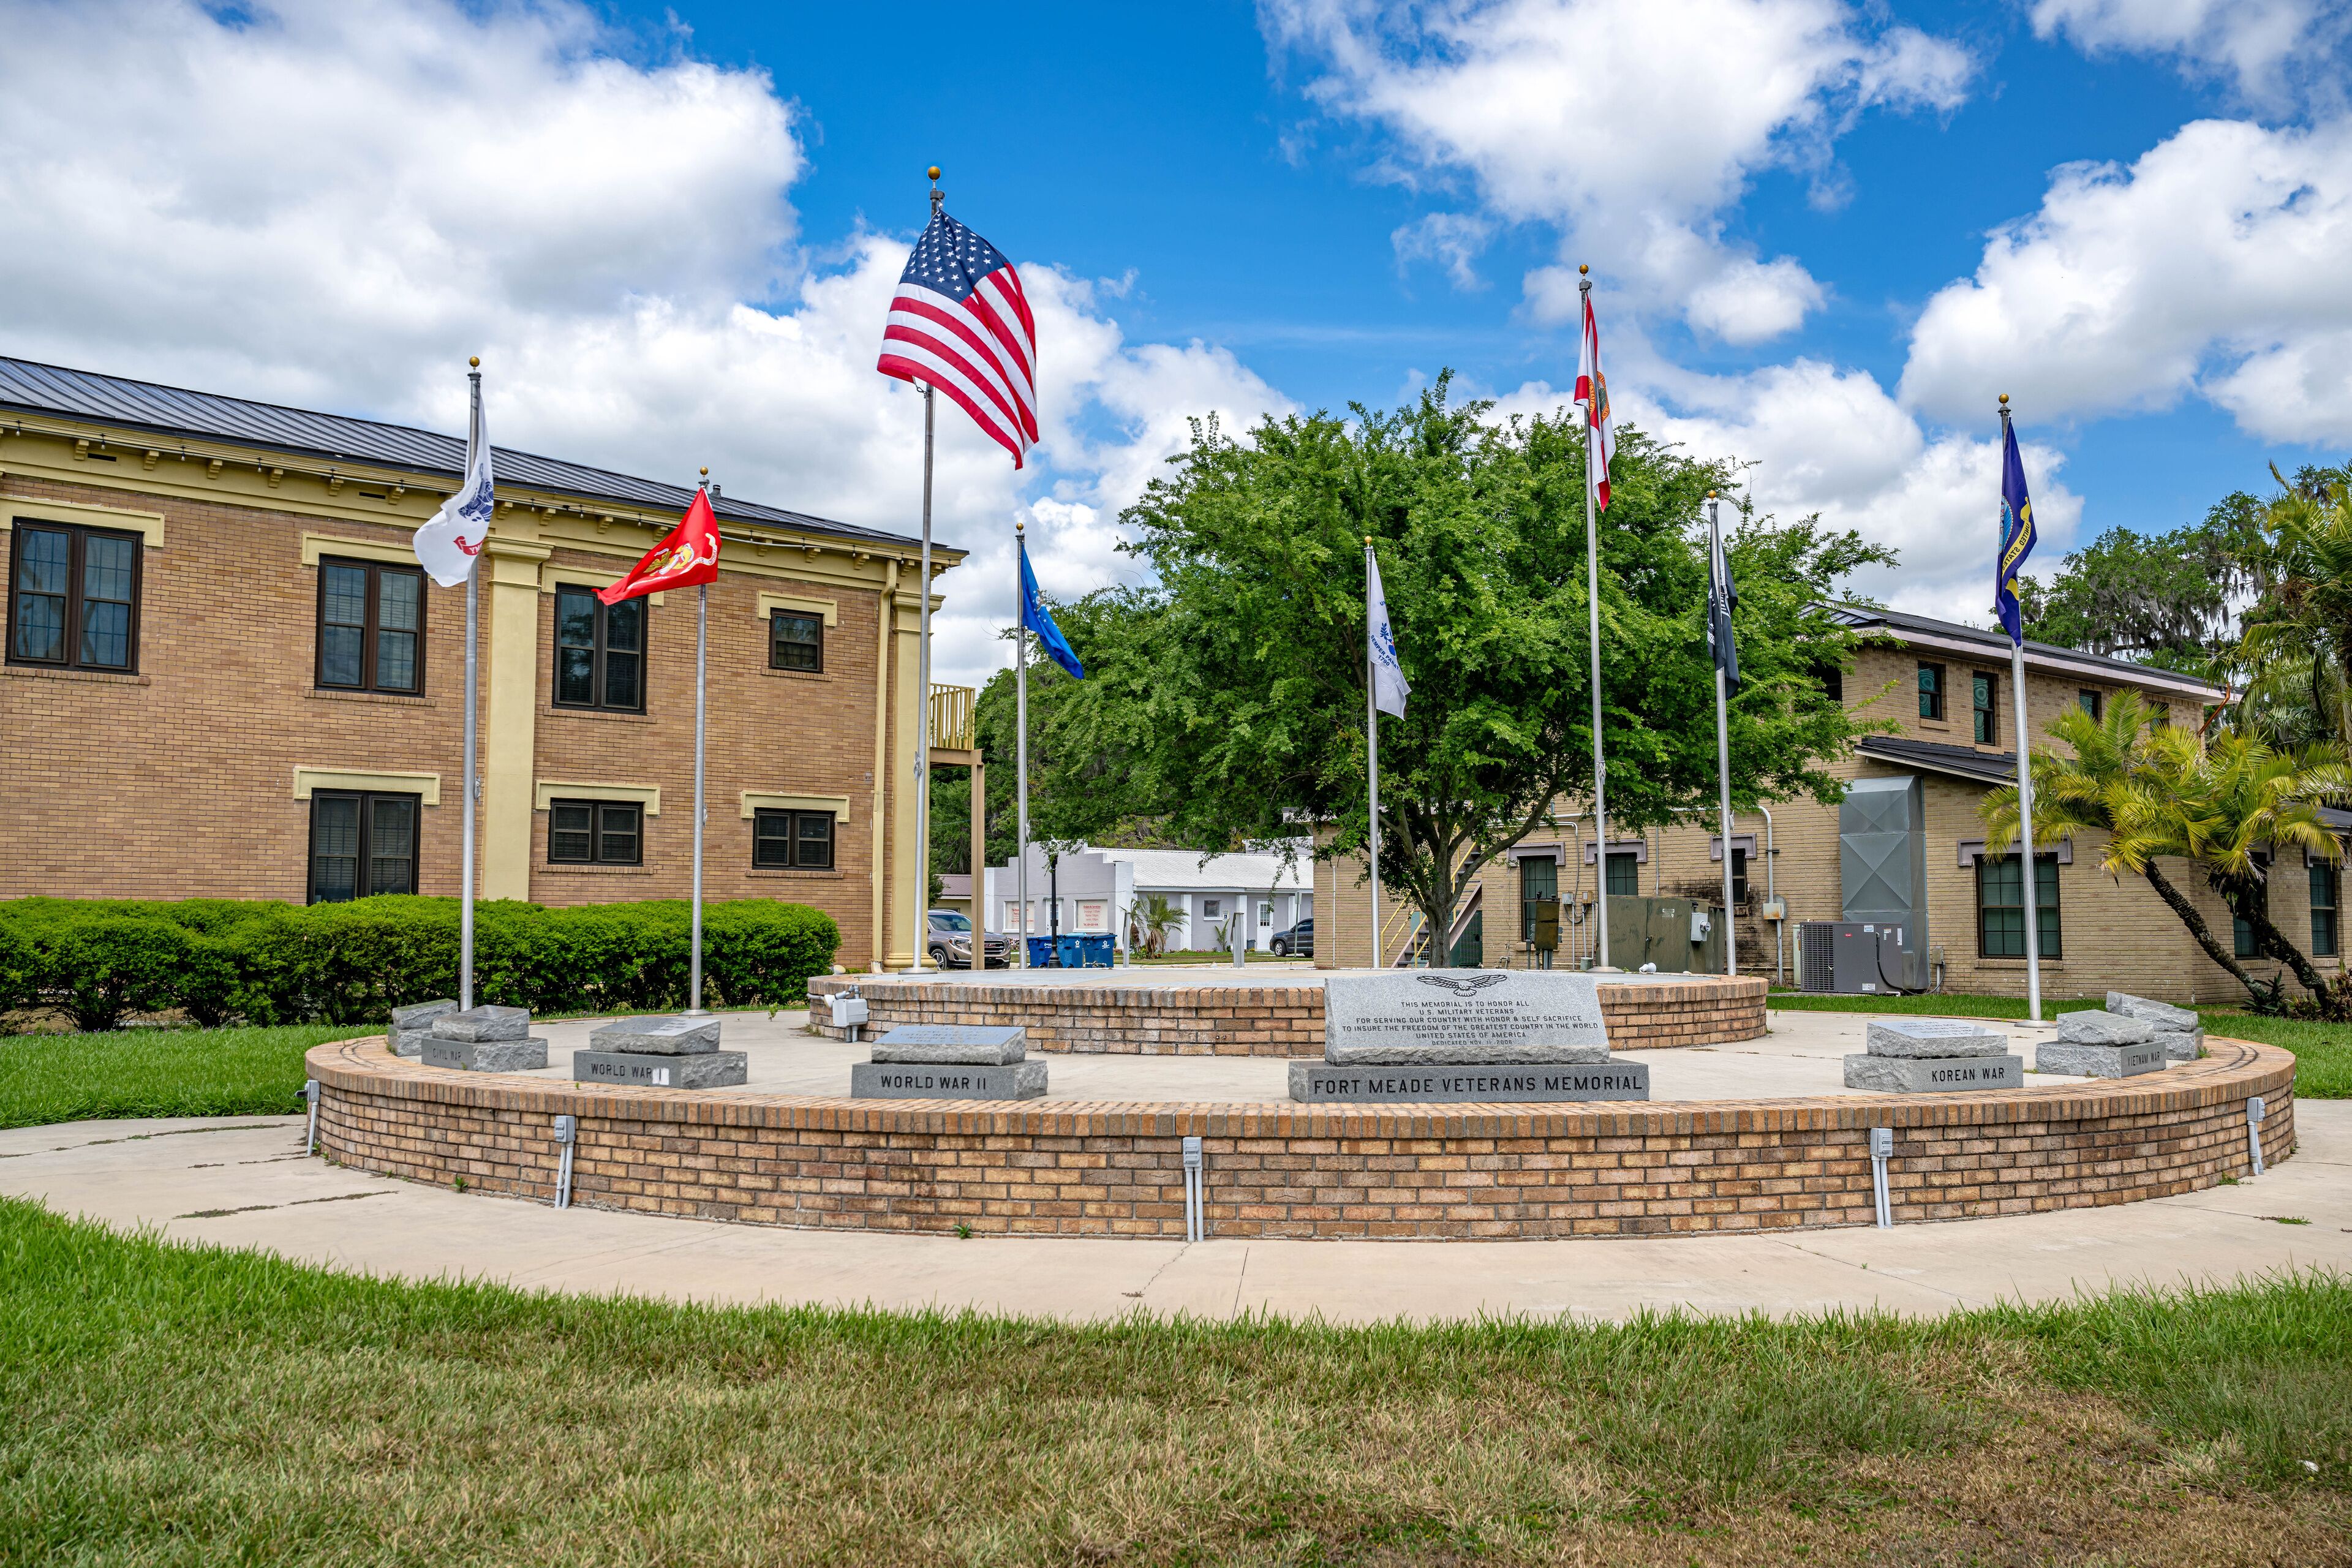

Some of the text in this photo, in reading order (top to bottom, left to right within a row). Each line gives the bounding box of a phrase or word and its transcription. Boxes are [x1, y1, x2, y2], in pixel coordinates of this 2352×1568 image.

[1371, 635, 1386, 656] SEMPER
[1378, 655, 1390, 666] 1790
[432, 1048, 462, 1061] CIVIL WAR
[2128, 1052, 2160, 1066] VIETNAM WAR
[590, 1063, 625, 1077] WORLD
[631, 1066, 652, 1079] WAR
[1932, 1068, 2005, 1082] KOREAN WAR
[881, 1076, 986, 1090] WORLD WAR II
[1314, 1076, 1643, 1094] FORT MEADE VETERANS MEMORIAL
